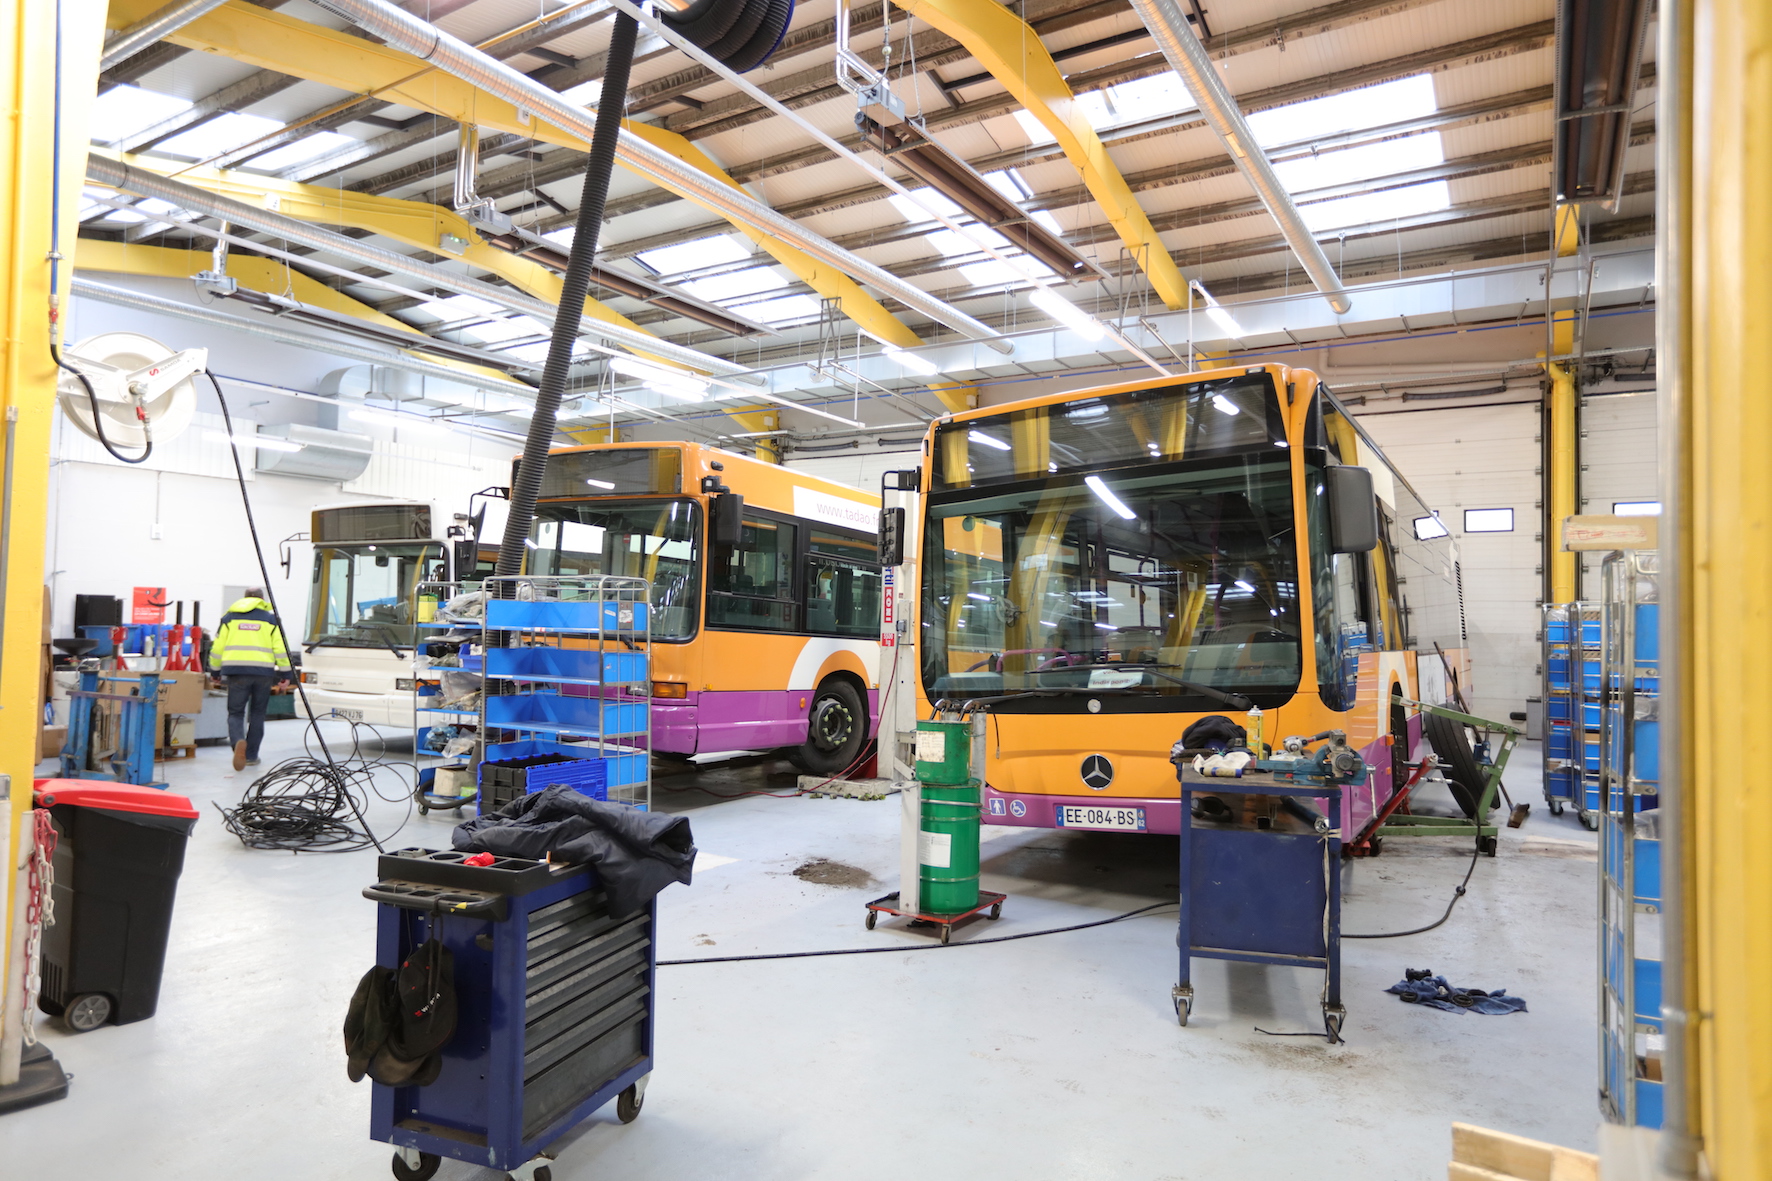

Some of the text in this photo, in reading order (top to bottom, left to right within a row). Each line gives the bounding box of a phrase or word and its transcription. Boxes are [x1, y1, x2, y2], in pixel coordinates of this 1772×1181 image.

[885, 588, 893, 622] KONI
[1066, 808, 1136, 825] EE-084-BS
[1138, 819, 1145, 827] 62
